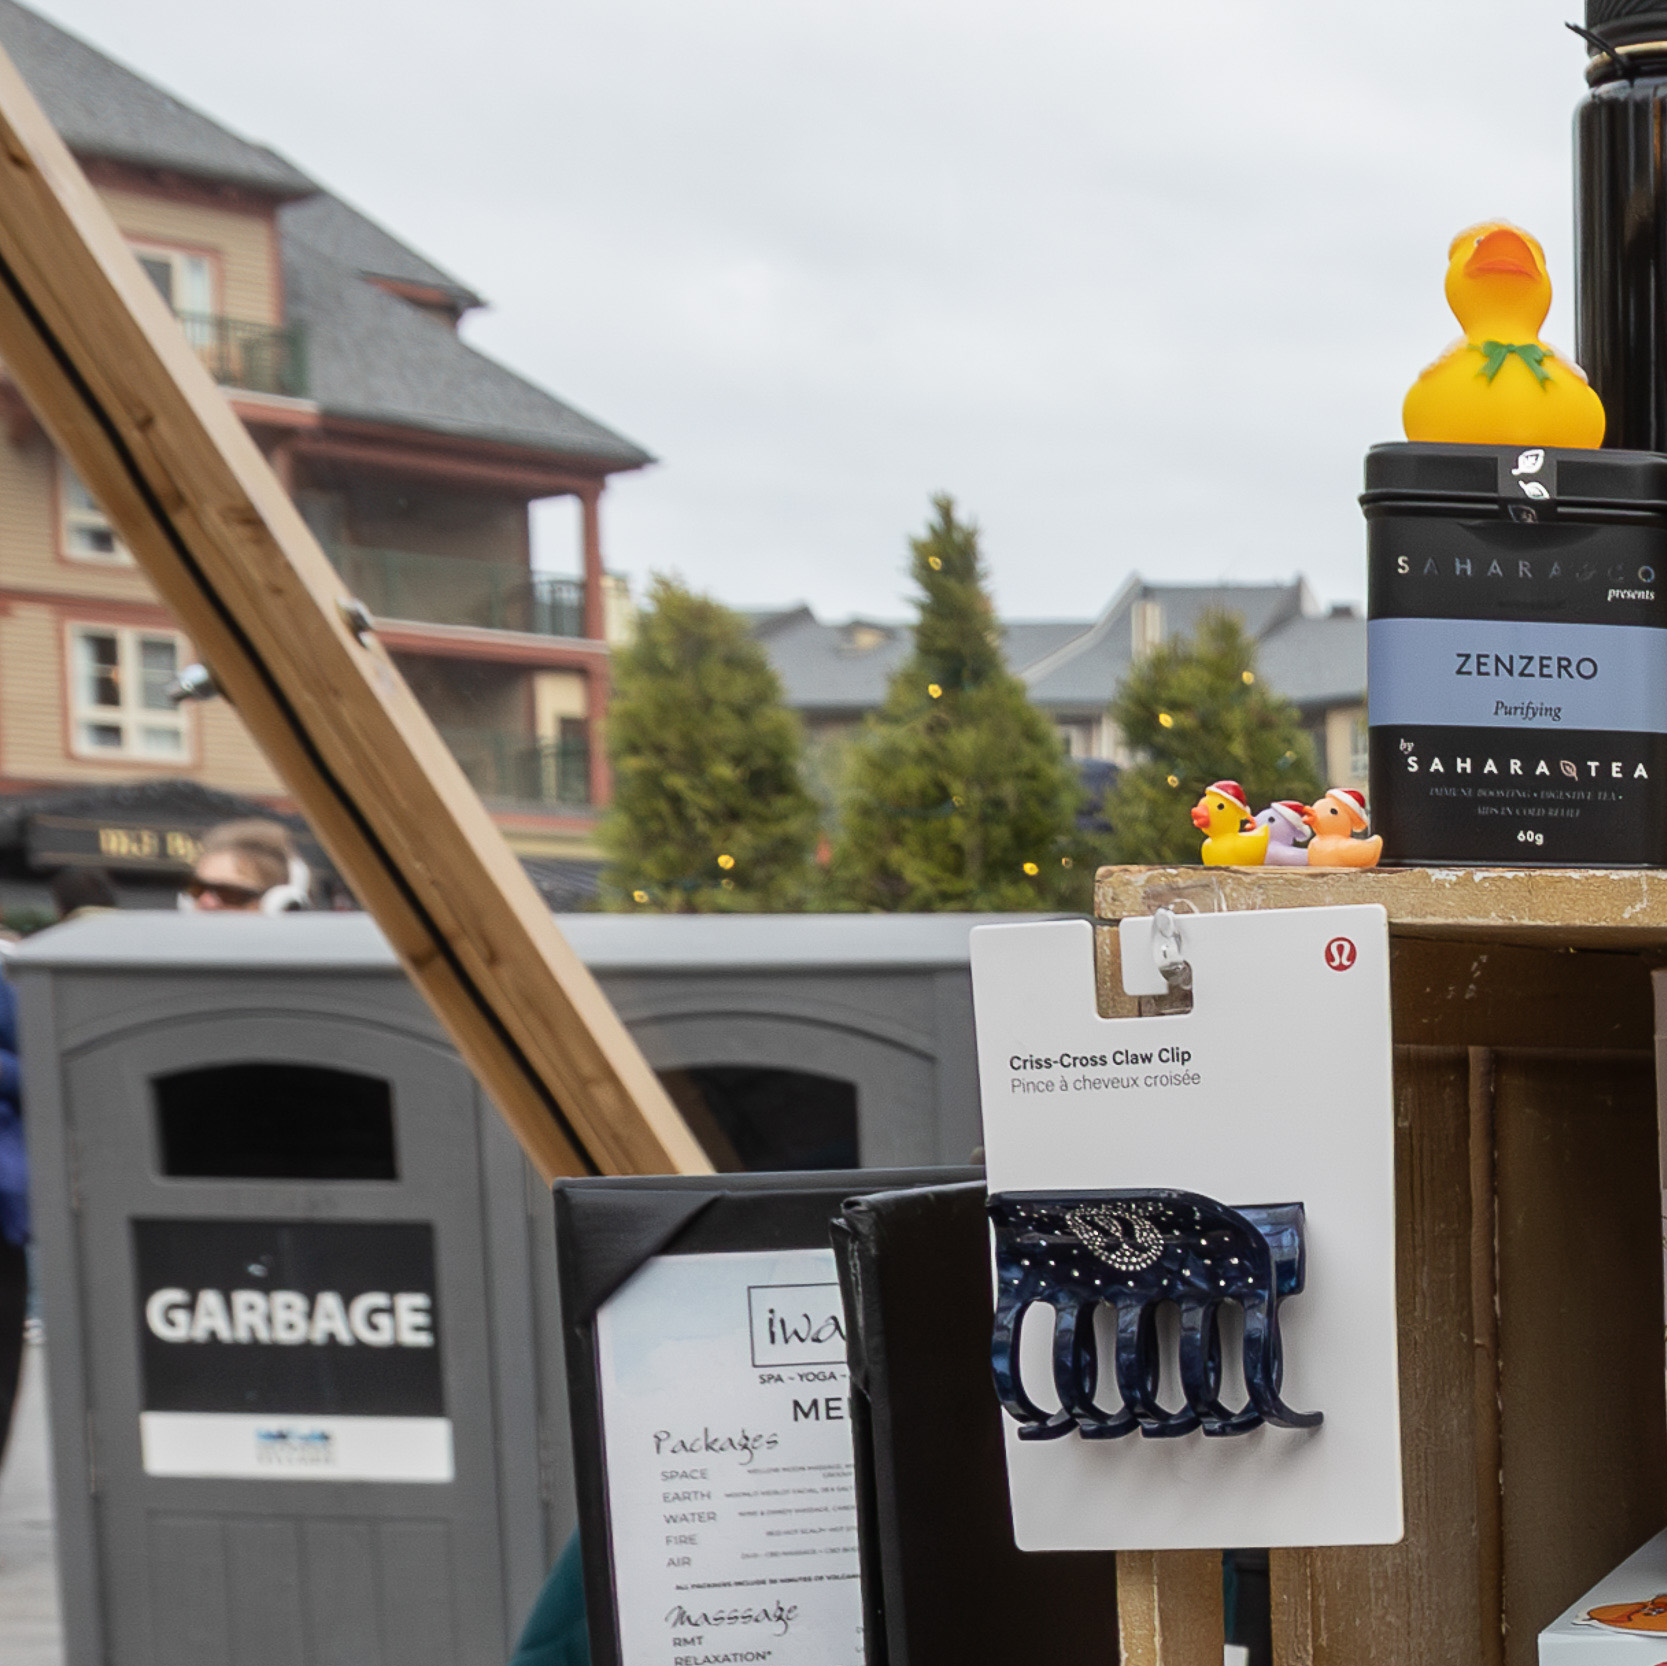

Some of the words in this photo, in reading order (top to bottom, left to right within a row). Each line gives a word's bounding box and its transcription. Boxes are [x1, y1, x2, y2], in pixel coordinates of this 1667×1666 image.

[1607, 587, 1655, 601] presents
[1455, 653, 1598, 680] ZENZERO
[1493, 700, 1562, 722] Purifying
[1400, 738, 1414, 754] by
[1407, 756, 1550, 777] SAHARA
[1586, 762, 1649, 779] TEA
[1517, 830, 1544, 845] 60g
[1009, 1051, 1107, 1071] Criss-Cross
[1112, 1049, 1153, 1066] Claw
[1158, 1046, 1192, 1067] Clip
[1011, 1077, 1055, 1094] Pince
[1060, 1074, 1069, 1092] à
[1073, 1073, 1139, 1091] cheveux
[1144, 1068, 1202, 1087] croisée
[146, 1287, 434, 1347] GARBAGE
[758, 1374, 785, 1385] SPA
[797, 1371, 838, 1382] YOGA
[653, 1427, 779, 1466] Packages
[661, 1468, 708, 1481] SPACE
[662, 1490, 712, 1503] EARTH
[663, 1511, 718, 1524] WATER
[665, 1534, 698, 1546] FIRE
[666, 1556, 692, 1568] AIR
[672, 1636, 704, 1648] RMT
